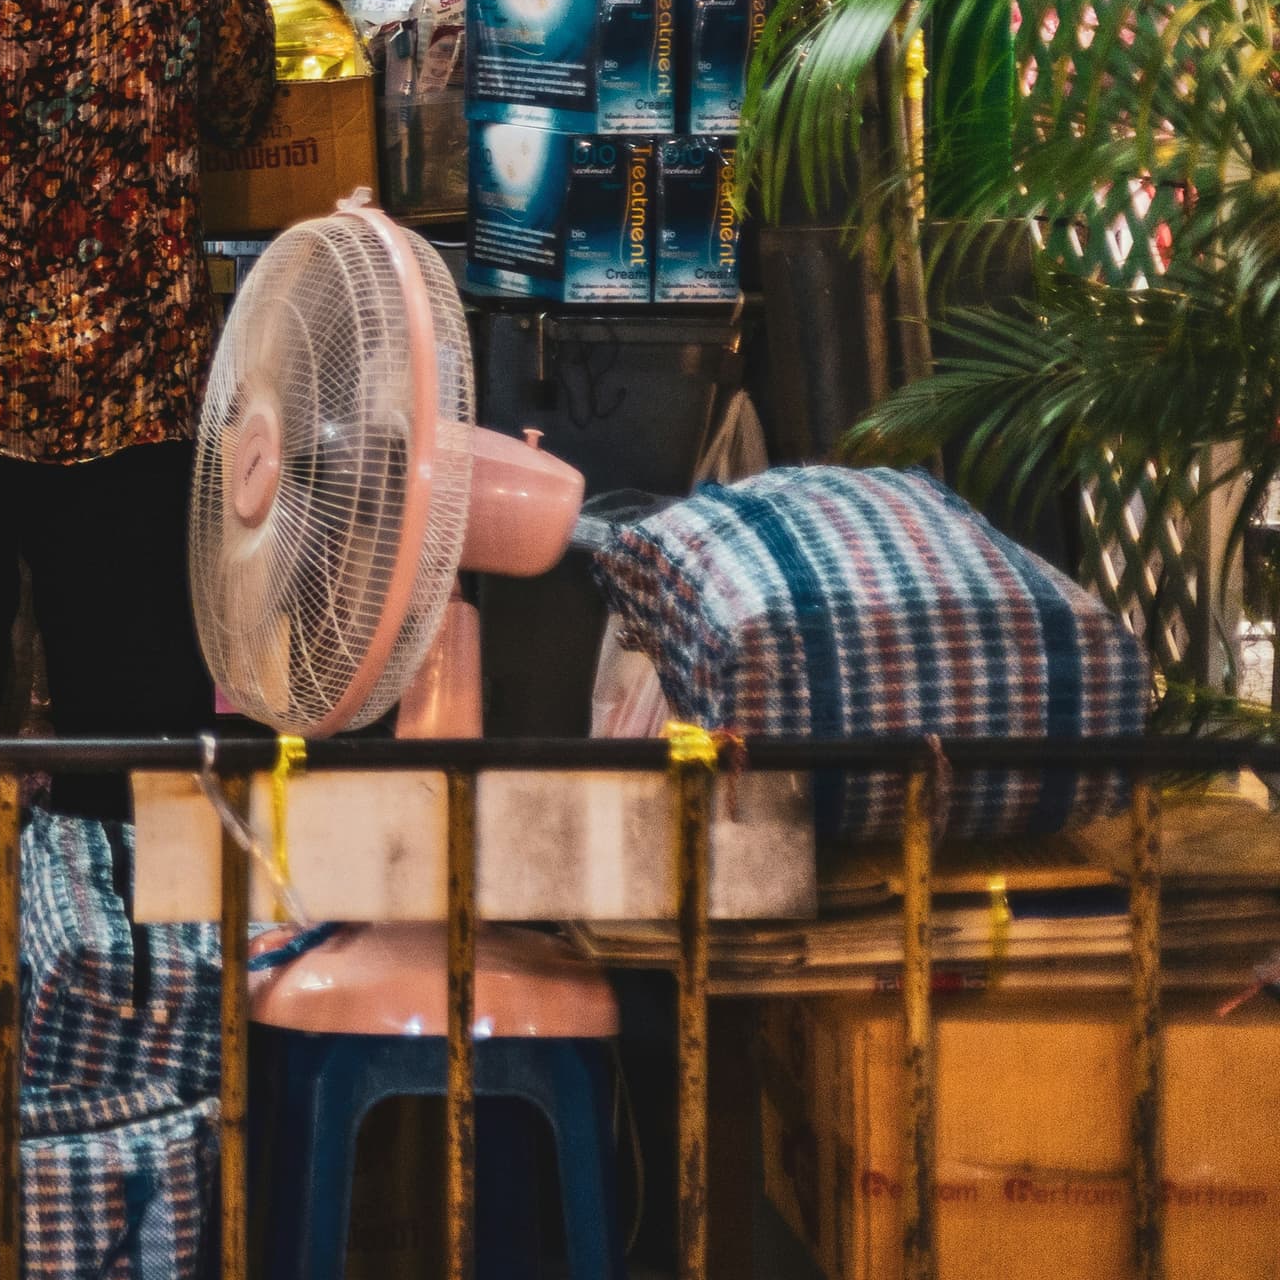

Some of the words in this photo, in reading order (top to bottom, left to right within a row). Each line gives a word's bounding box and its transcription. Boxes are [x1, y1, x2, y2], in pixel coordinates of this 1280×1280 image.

[573, 145, 617, 165] bio
[630, 145, 653, 268] Treatment
[571, 230, 587, 239] bio
[606, 268, 648, 281] Cream
